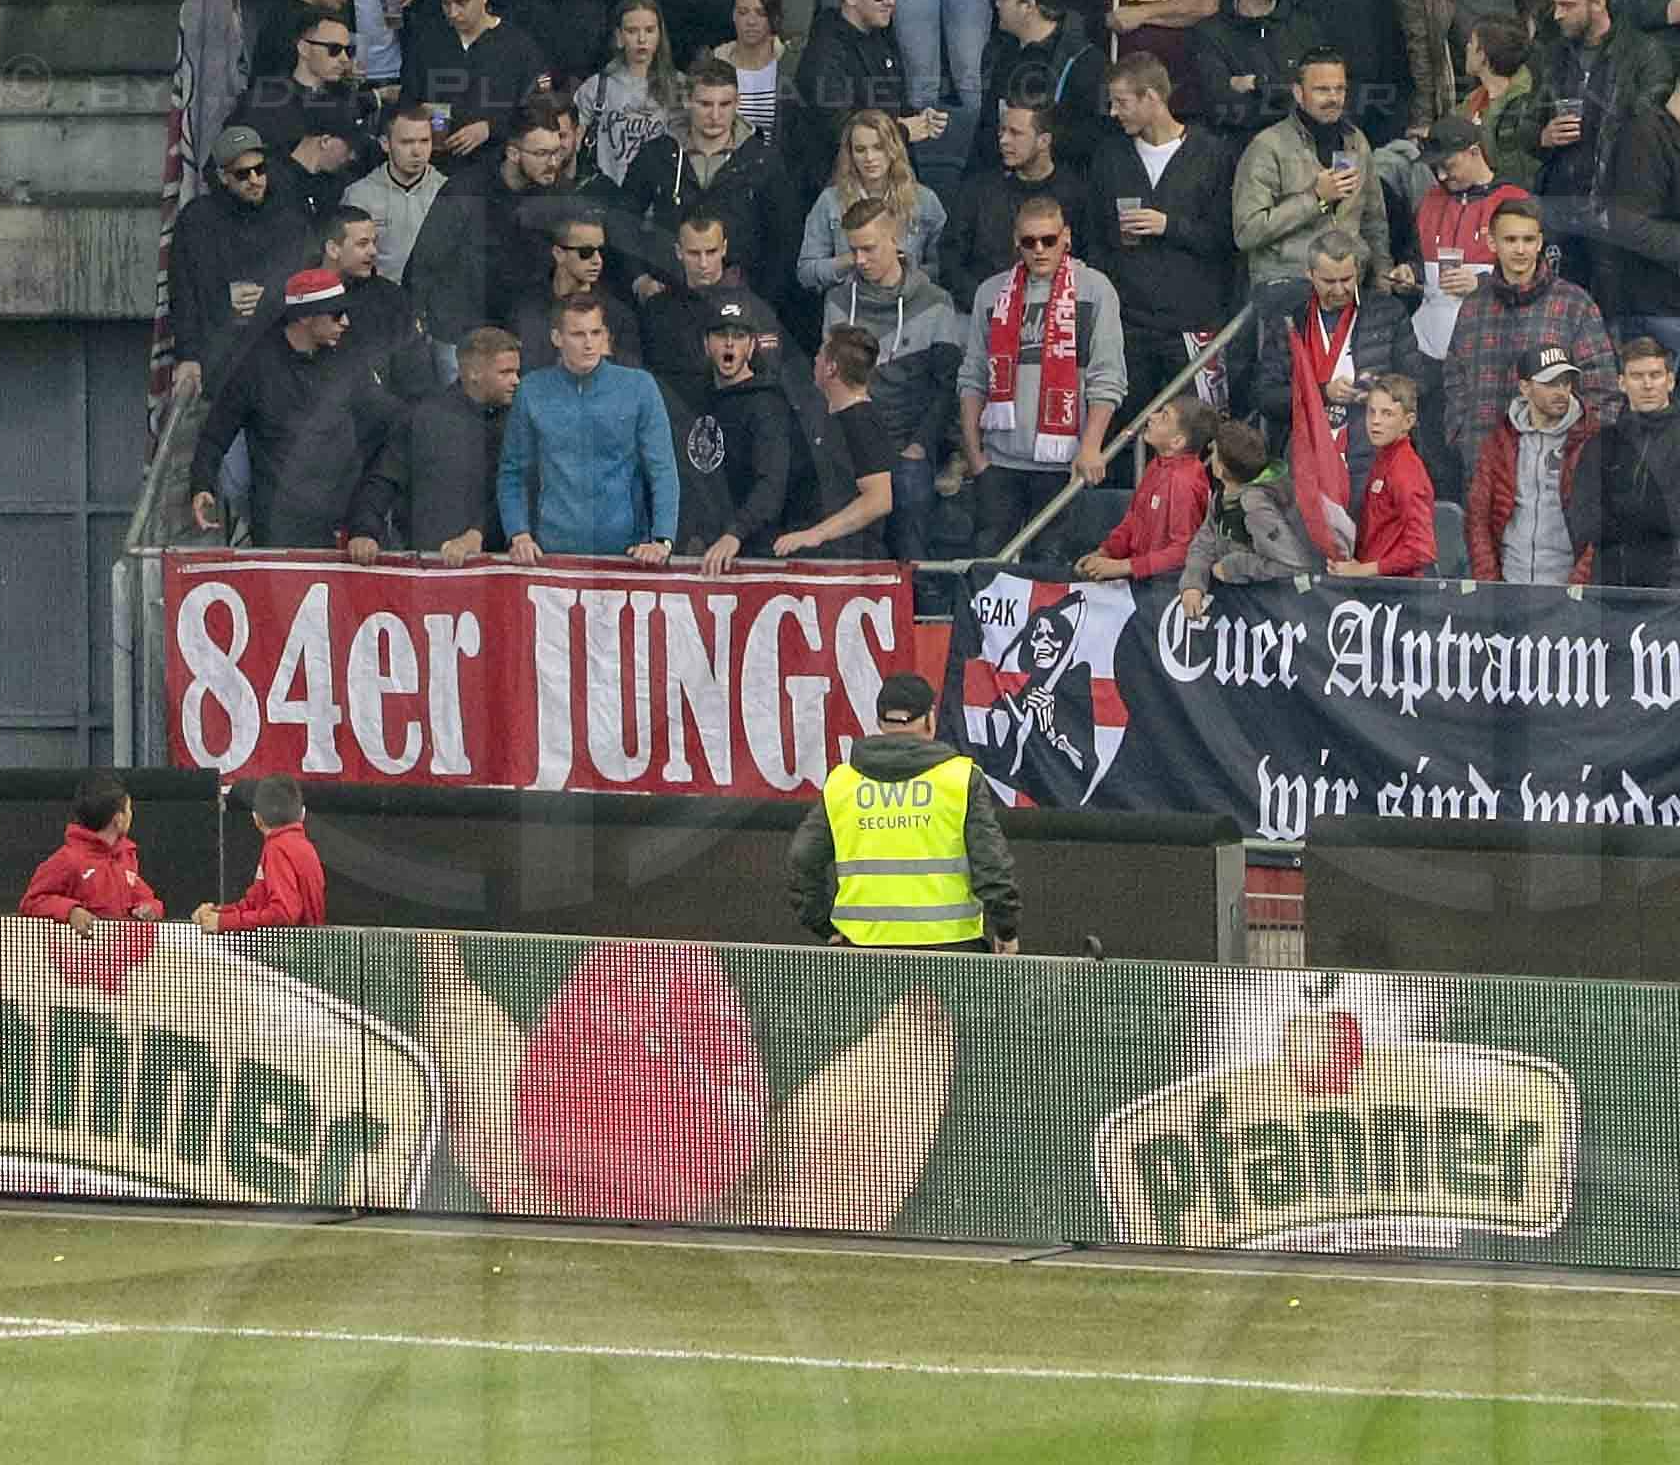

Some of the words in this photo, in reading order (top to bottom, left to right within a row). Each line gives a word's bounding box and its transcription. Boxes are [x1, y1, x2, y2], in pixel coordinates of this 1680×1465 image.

[976, 594, 1018, 627] GAK
[1323, 598, 1611, 717] Alptraum
[176, 579, 483, 776] 84er
[527, 582, 898, 791] JUNGS
[856, 780, 933, 810] OWD
[858, 814, 932, 830] SECURITY
